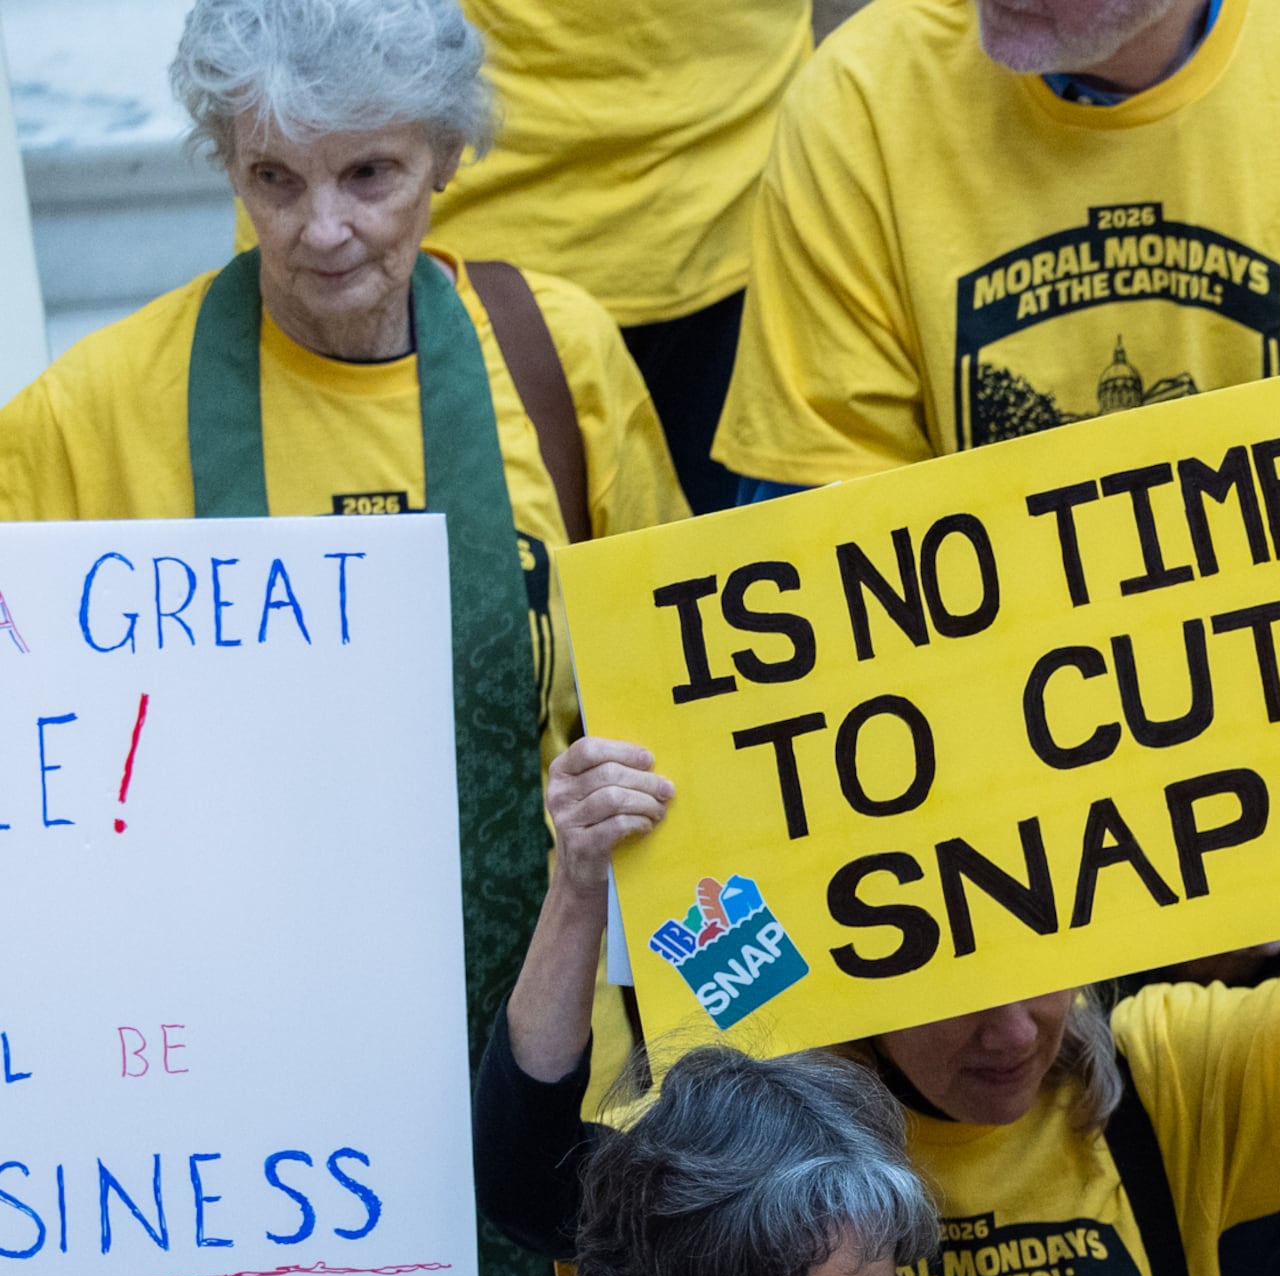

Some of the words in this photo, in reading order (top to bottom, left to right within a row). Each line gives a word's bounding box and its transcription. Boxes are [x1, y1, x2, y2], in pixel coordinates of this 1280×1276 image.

[1098, 207, 1155, 230] 2026
[973, 242, 1099, 310] MORAL
[1104, 234, 1270, 295] MONDAYS
[1016, 285, 1053, 320] AT
[1055, 273, 1110, 306] THE
[343, 496, 401, 514] 2026
[79, 552, 366, 654] GREAT
[653, 560, 817, 705] IS
[835, 513, 999, 662] NO
[732, 694, 935, 840] TO
[826, 767, 1270, 979] SNAP
[697, 922, 784, 1015] SNAP
[117, 1024, 189, 1077] BE
[939, 1219, 989, 1240] 2026
